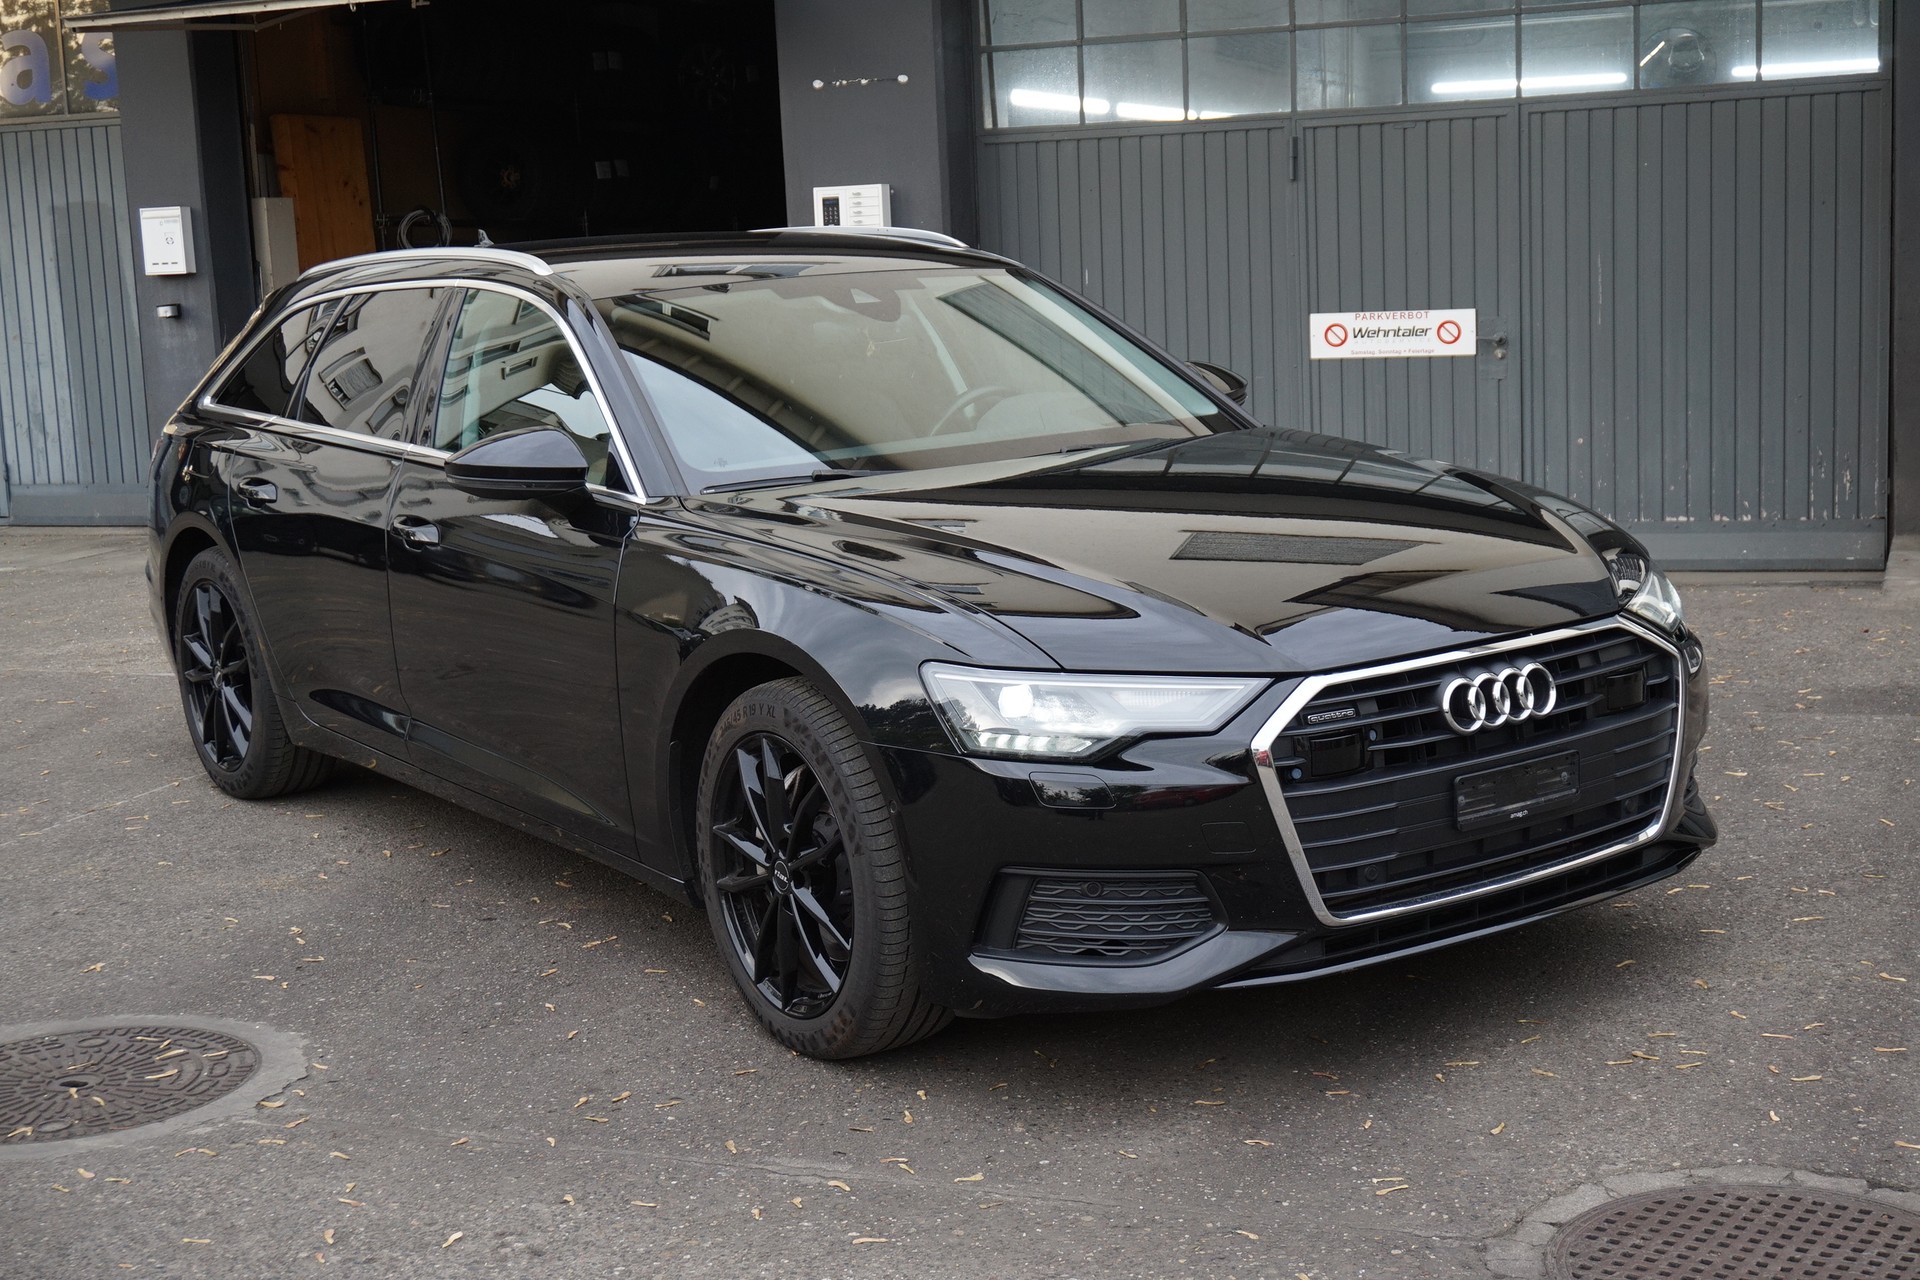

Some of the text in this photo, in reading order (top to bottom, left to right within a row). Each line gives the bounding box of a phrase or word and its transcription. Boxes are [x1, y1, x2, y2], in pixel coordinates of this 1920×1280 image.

[1354, 311, 1430, 321] PARKVERBOT
[1352, 325, 1432, 339] Wehntaler
[1310, 710, 1354, 723] quattro
